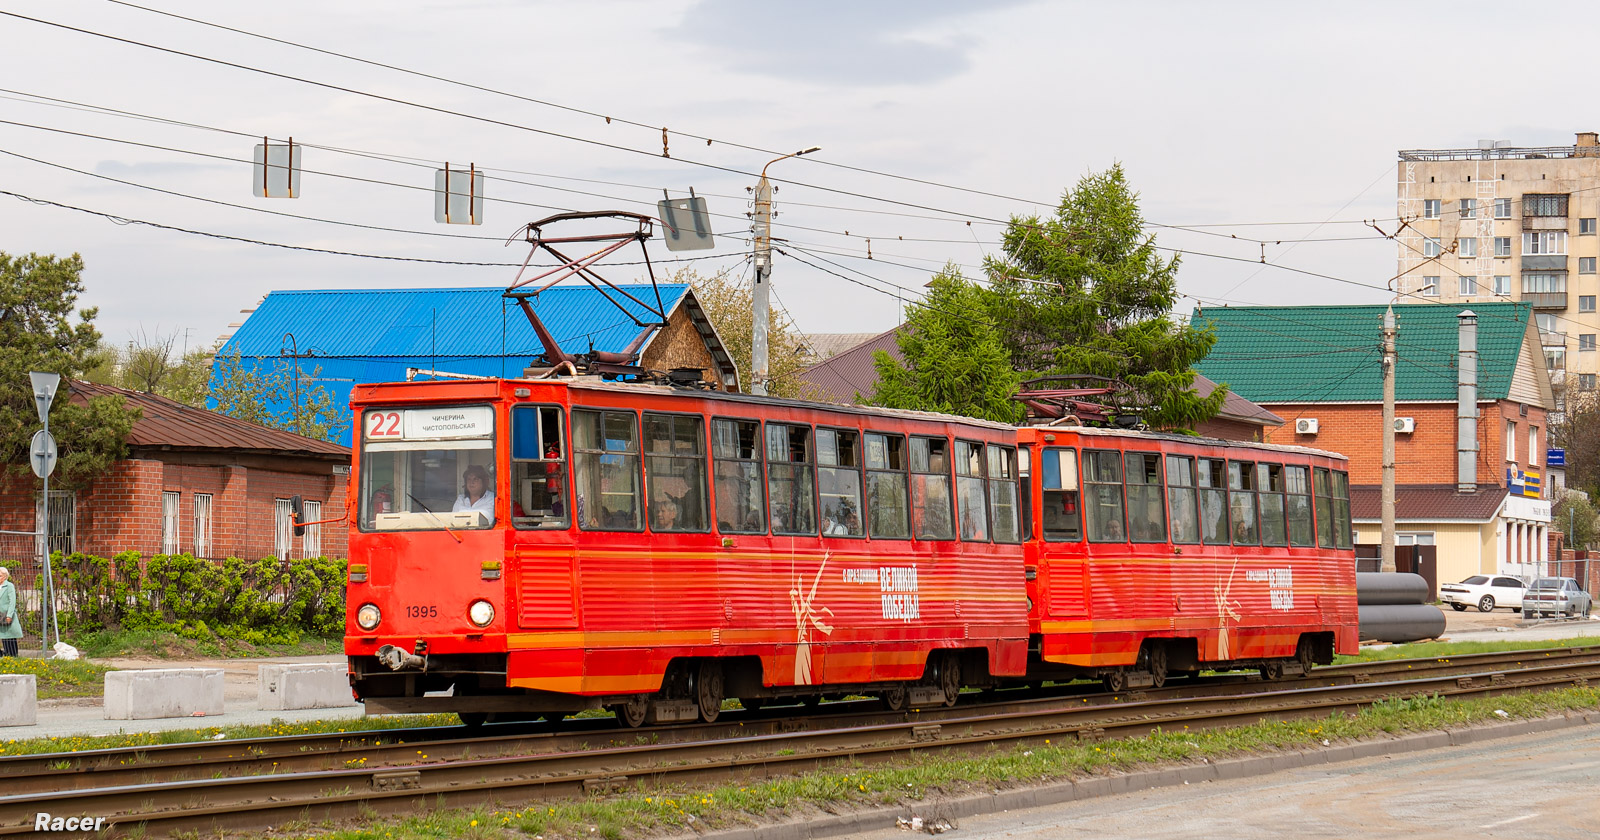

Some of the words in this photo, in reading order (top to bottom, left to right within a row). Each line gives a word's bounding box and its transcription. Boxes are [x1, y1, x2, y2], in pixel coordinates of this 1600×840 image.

[370, 412, 400, 436] 22
[422, 422, 476, 432] ЧИСТОПОЛЬСКАЯ
[432, 414, 465, 422] ЧИЧЕРИНА
[880, 563, 918, 592] ВЕЛИКОЙ
[406, 605, 438, 618] 1395
[882, 595, 920, 623] ПОБЕДЫ!
